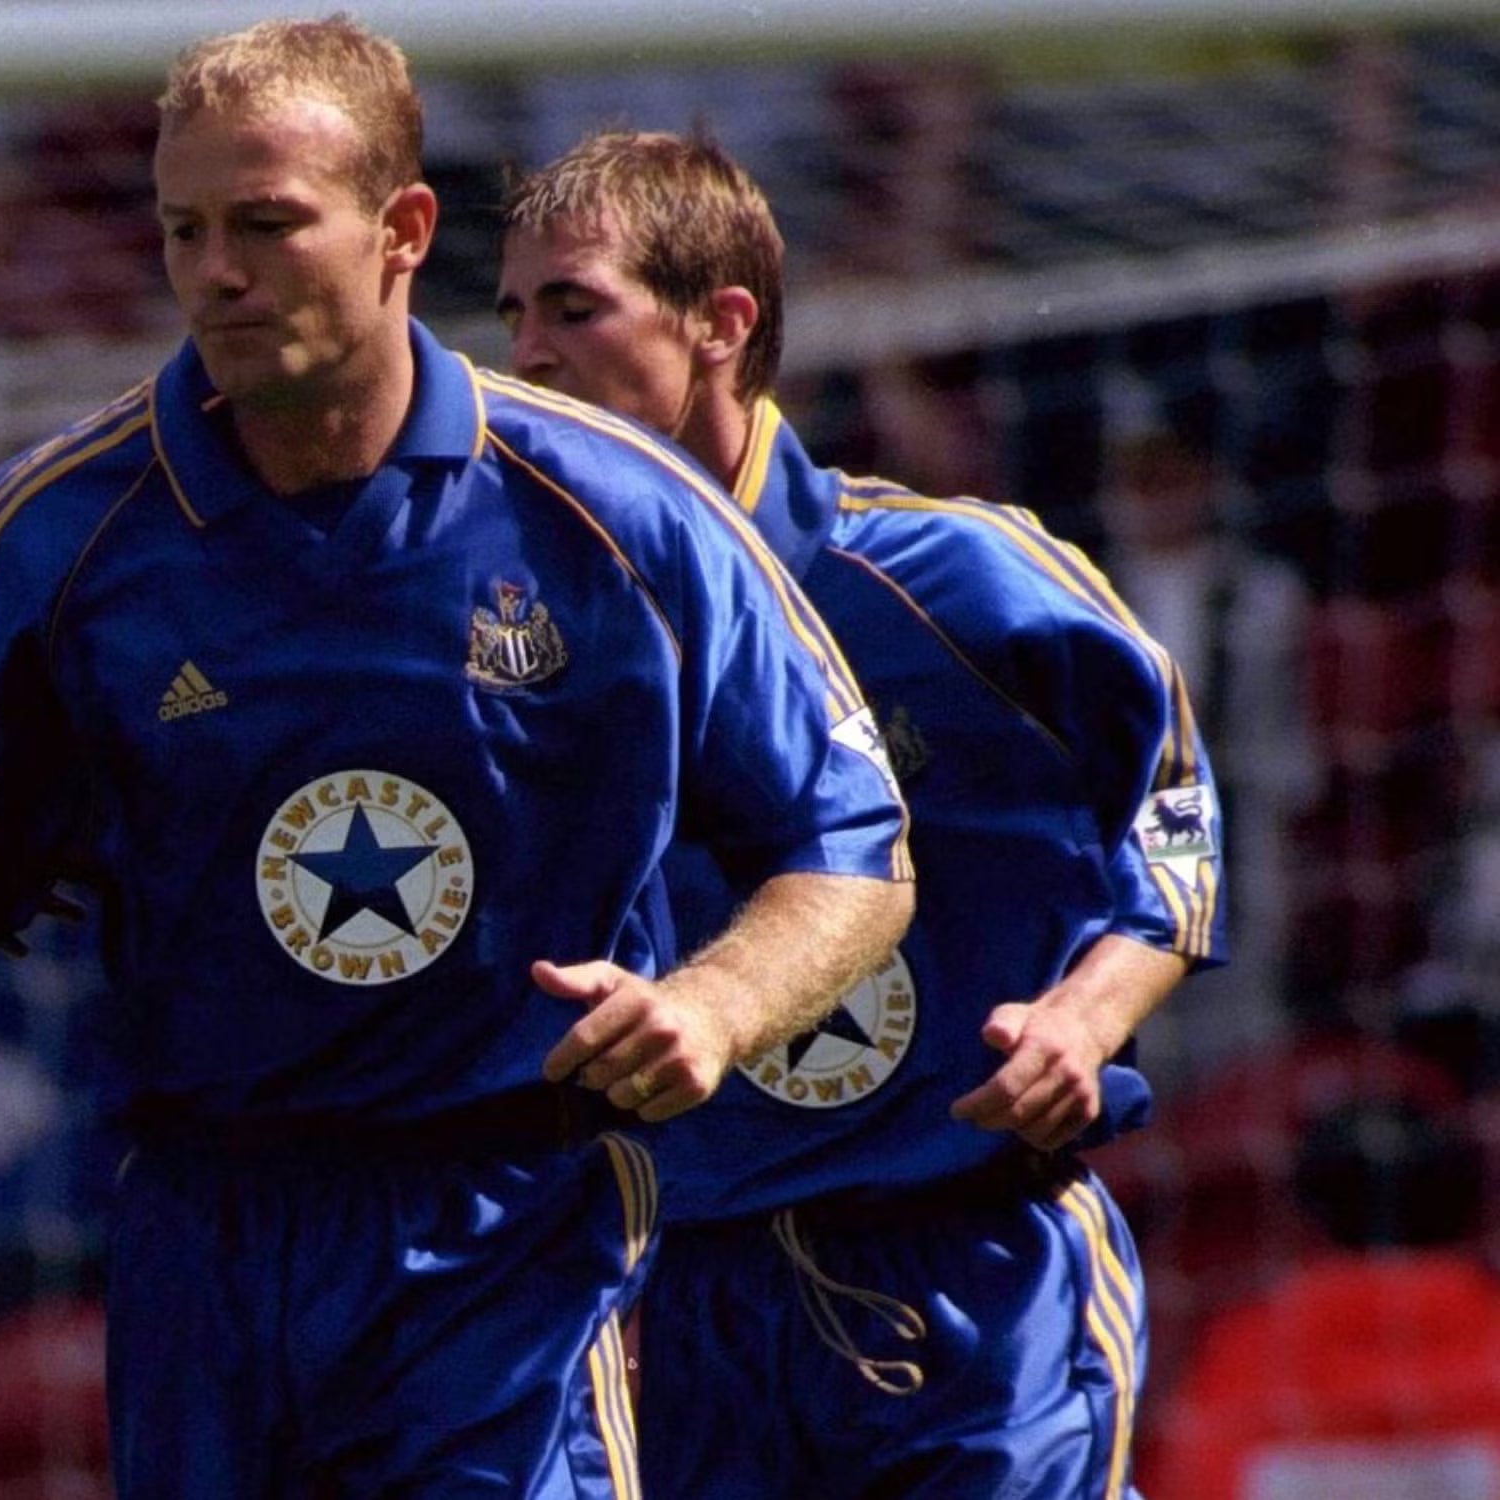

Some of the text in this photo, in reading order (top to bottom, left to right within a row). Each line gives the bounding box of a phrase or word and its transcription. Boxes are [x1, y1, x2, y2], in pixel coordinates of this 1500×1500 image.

[159, 691, 228, 722] adidas
[261, 777, 464, 881] NEWCASTLE
[270, 888, 468, 980] BROWN ALE
[876, 994, 911, 1061] ALE
